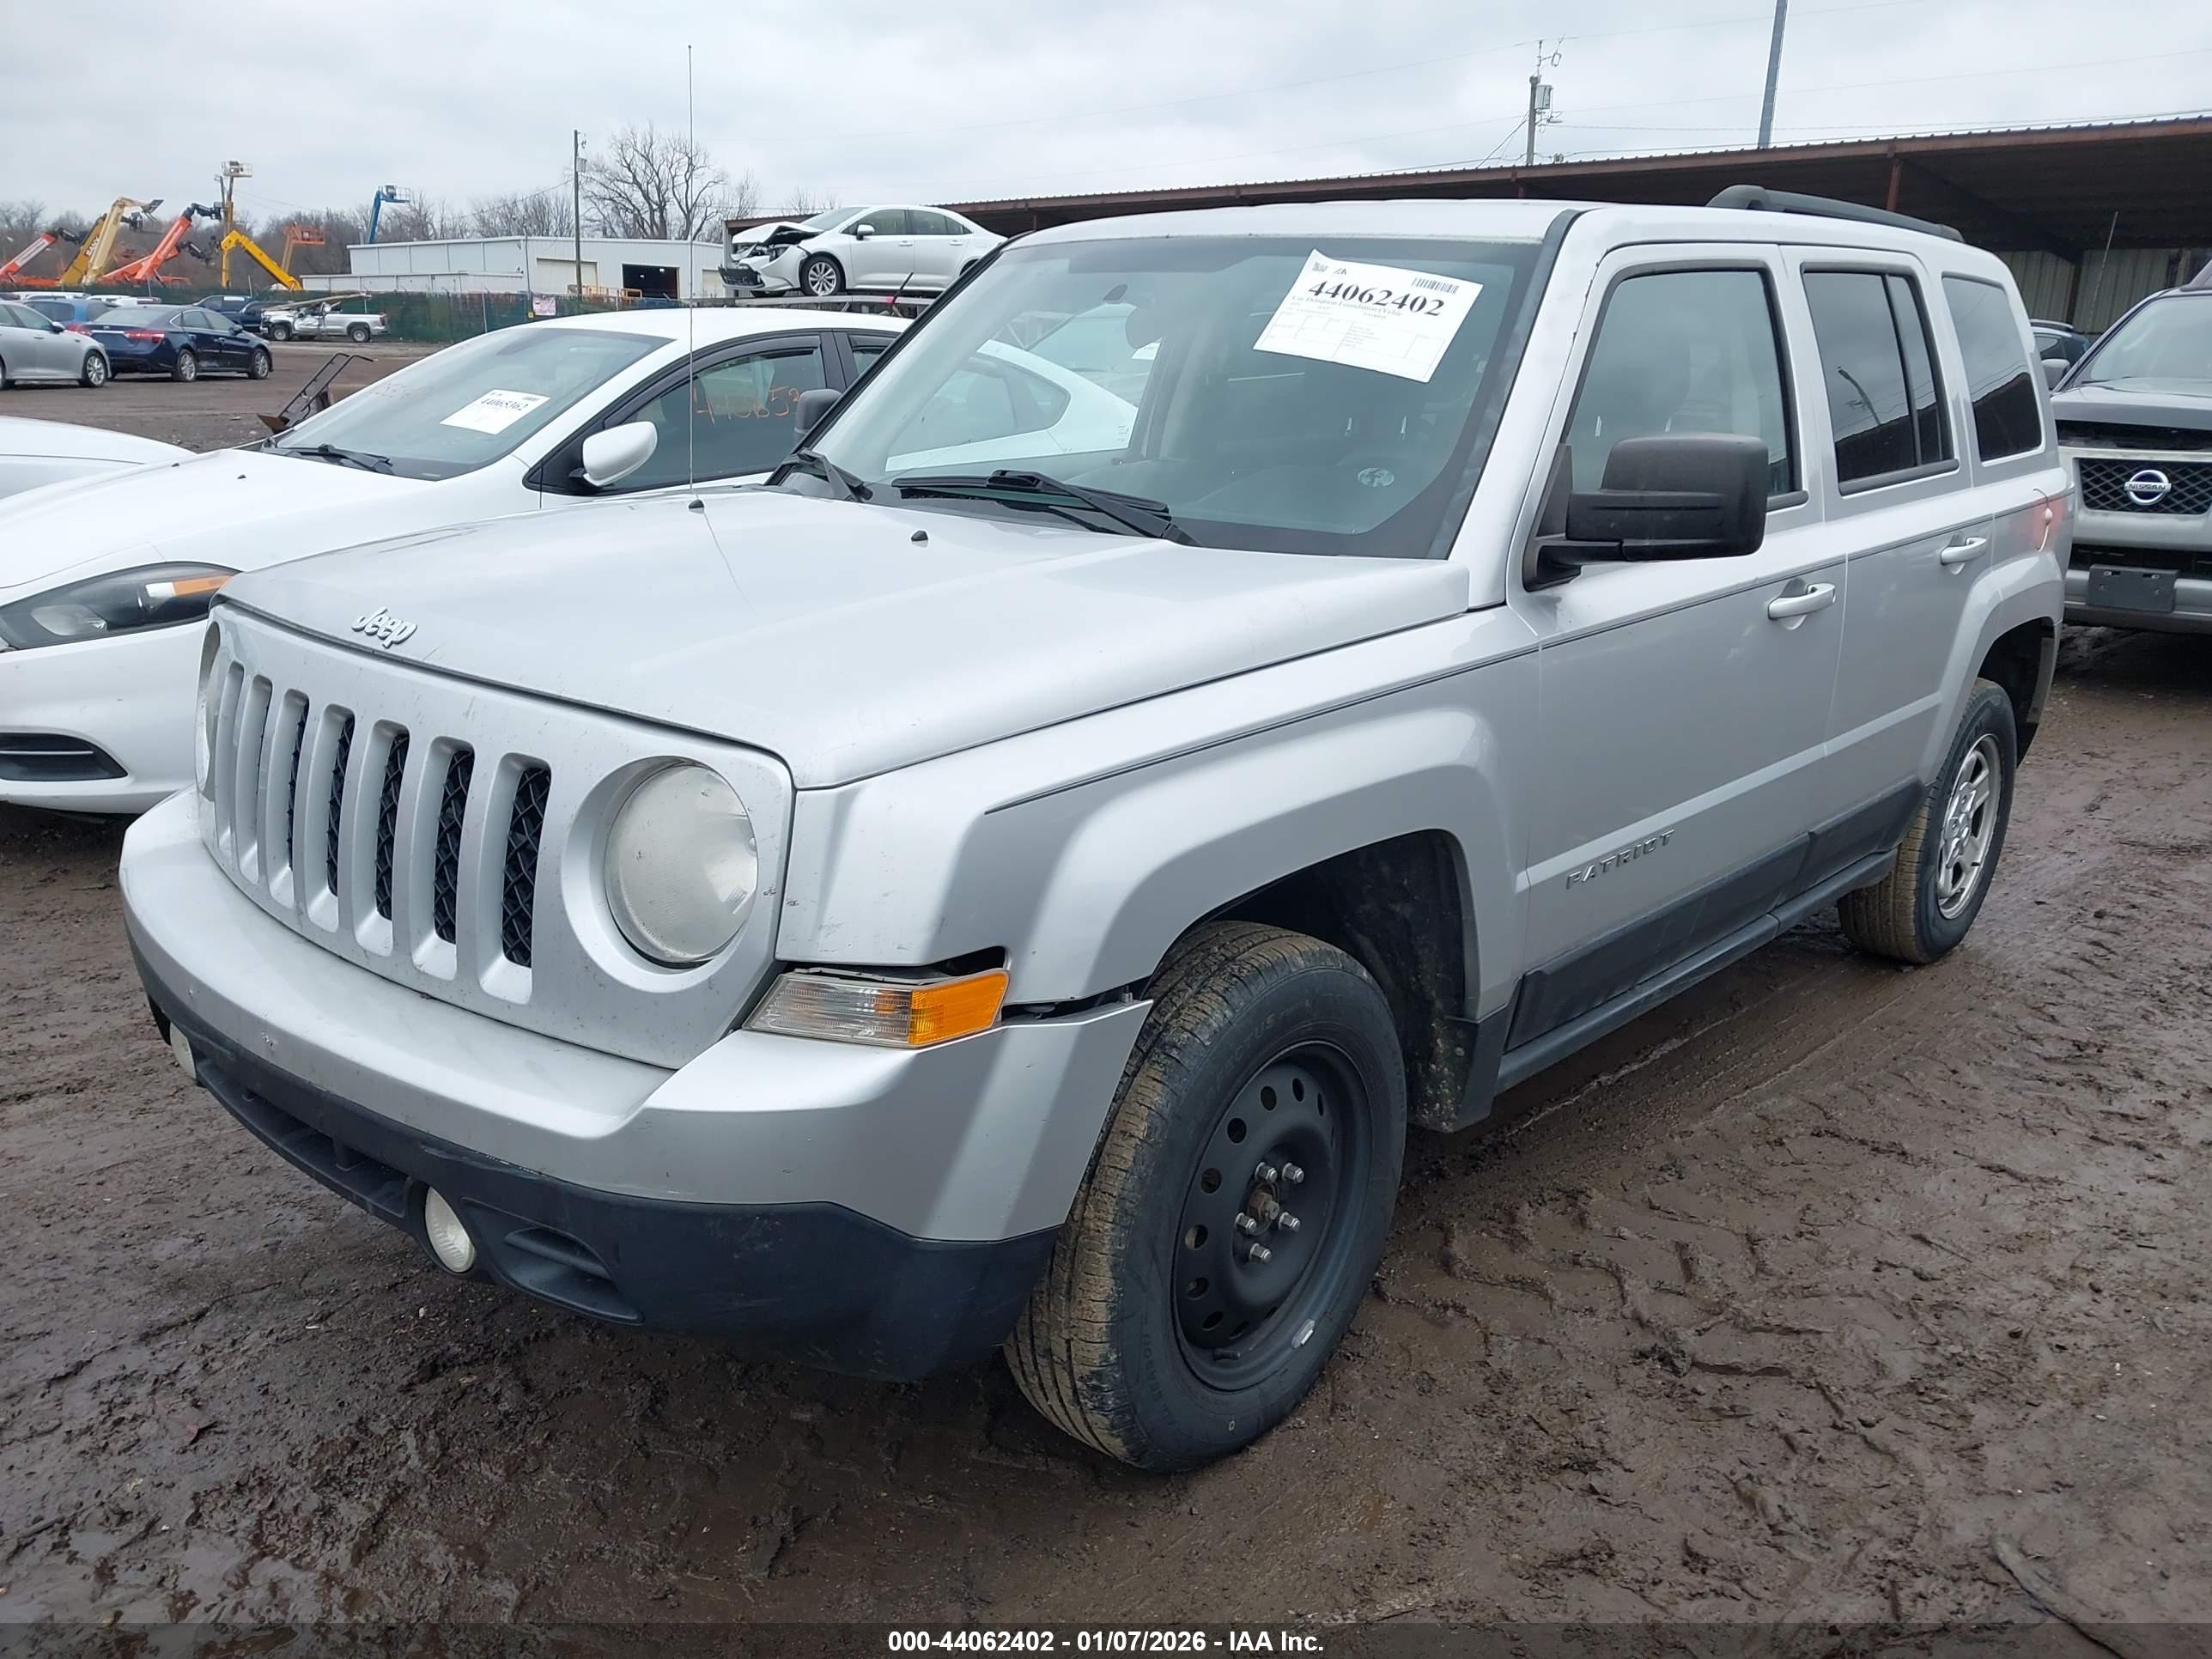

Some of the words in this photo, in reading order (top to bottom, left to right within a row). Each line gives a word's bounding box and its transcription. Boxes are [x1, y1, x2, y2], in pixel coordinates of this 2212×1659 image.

[1309, 281, 1444, 317] 44062402
[351, 606, 418, 650] Jeep
[1565, 829, 1676, 890] PATRIOT
